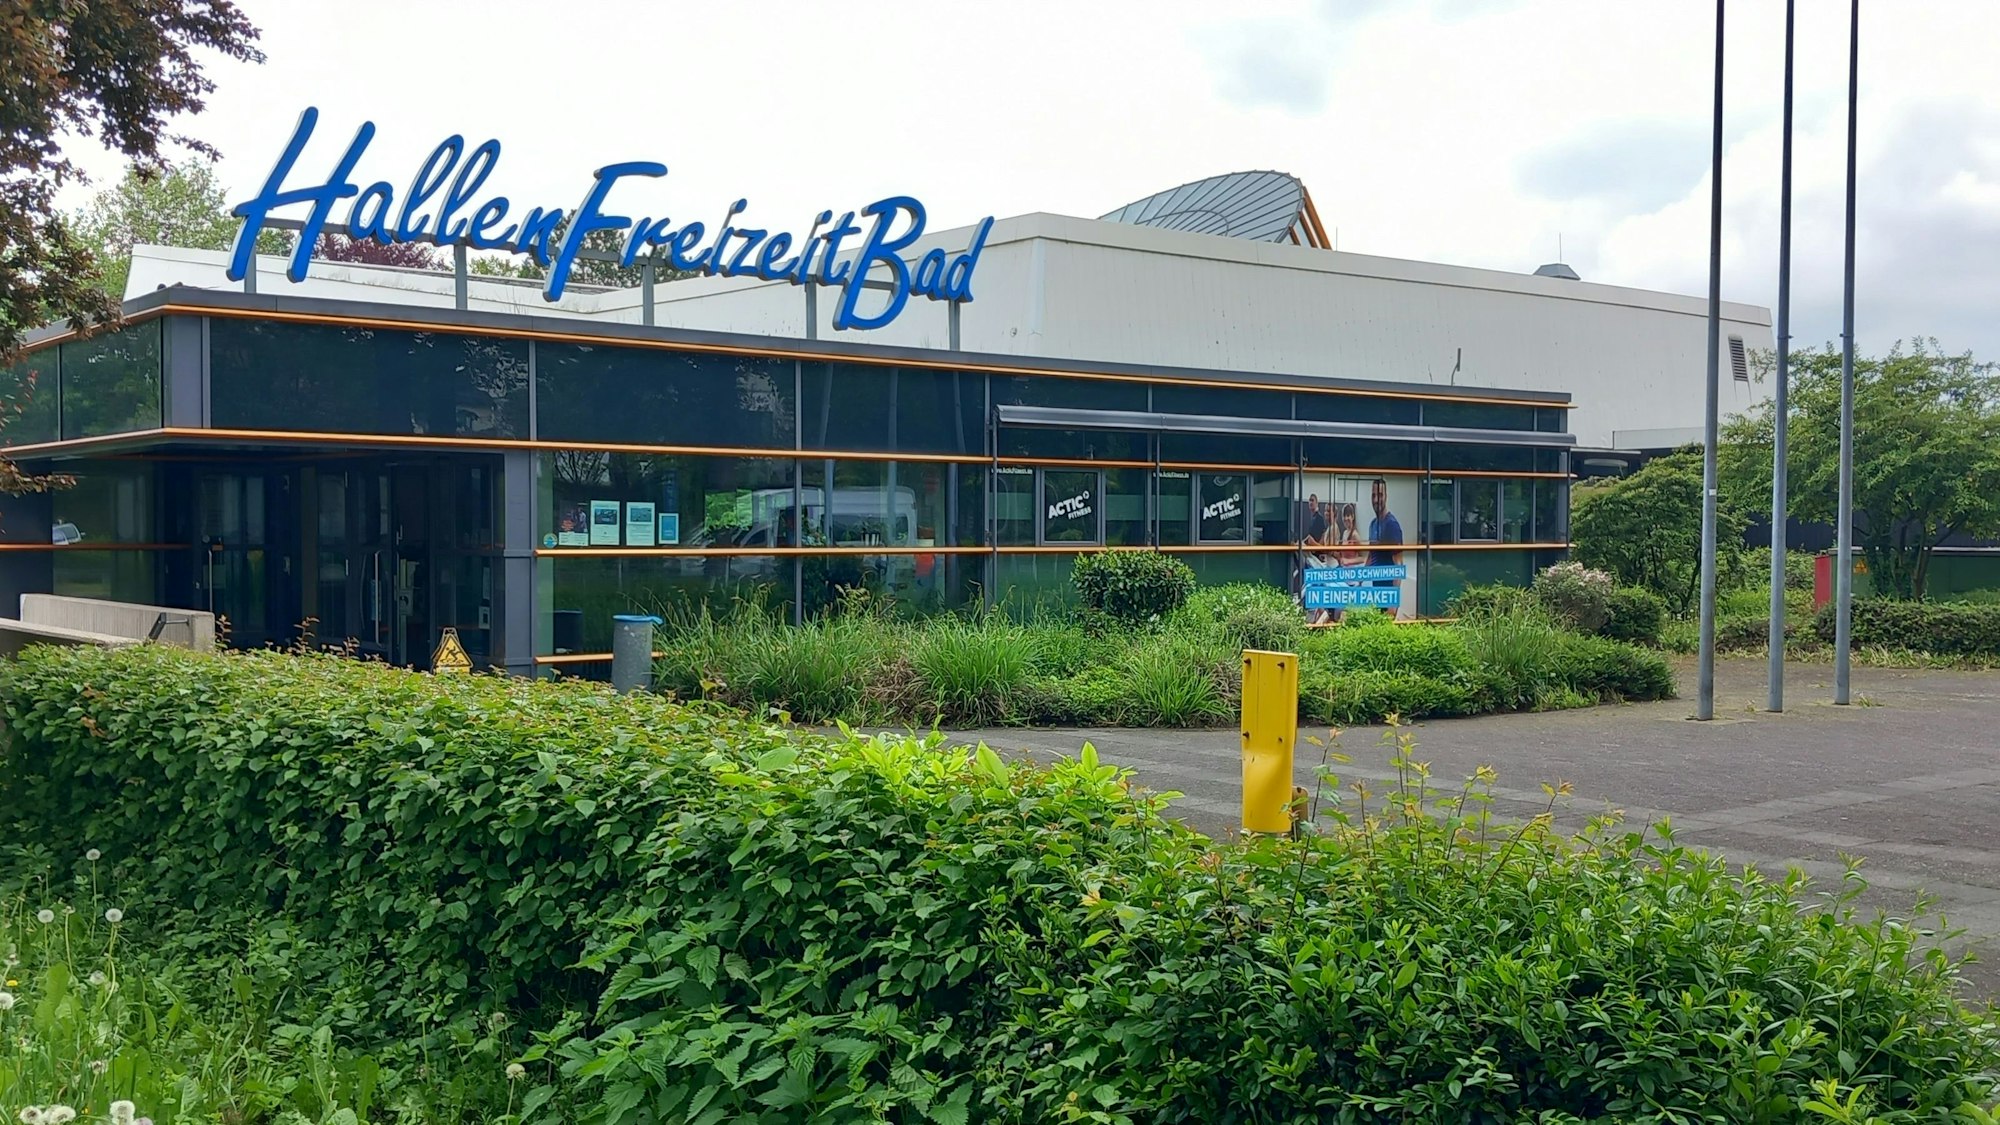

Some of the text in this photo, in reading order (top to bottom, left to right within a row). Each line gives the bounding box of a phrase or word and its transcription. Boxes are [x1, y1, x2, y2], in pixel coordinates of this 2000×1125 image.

[226, 106, 995, 331] HallenFreizeitBad
[1048, 495, 1085, 519] ACTIC
[1067, 506, 1092, 520] FITNESS
[1203, 498, 1235, 520] ACTIC
[1220, 508, 1242, 521] FITNESS
[1305, 567, 1405, 581] FITNESS UND SCHWIMMEN
[1308, 590, 1398, 604] IN EINEM PAKET!
